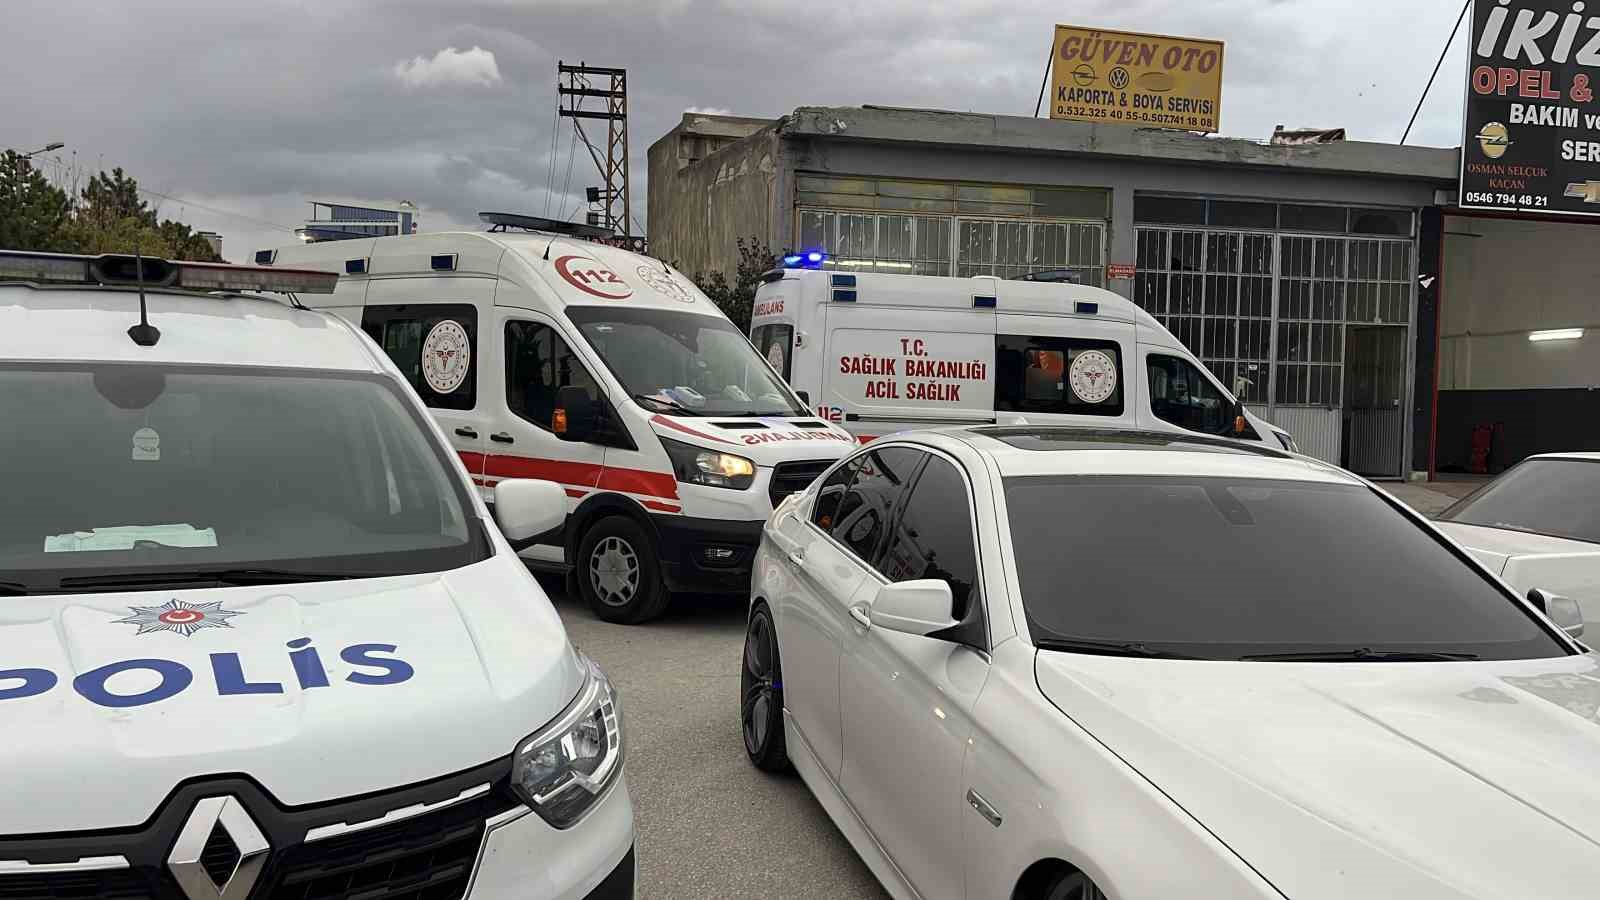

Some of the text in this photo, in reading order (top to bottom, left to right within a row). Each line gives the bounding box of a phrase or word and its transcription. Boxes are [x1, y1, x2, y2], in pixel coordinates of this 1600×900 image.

[1060, 32, 1217, 74] GÜVEN OTO
[1472, 66, 1593, 102] OPEL &
[1058, 86, 1115, 107] KAPORTA
[1120, 93, 1128, 108] &
[1133, 94, 1163, 111] BOYA
[1110, 109, 1123, 119] 40
[1187, 116, 1198, 126] 18
[1200, 118, 1213, 128] 08
[1509, 103, 1579, 128] BAKIM
[1467, 163, 1505, 175] OSMAN
[1466, 191, 1548, 206] 0546 794 48 21
[571, 269, 625, 284] 112
[901, 338, 928, 357] T.C.
[840, 354, 986, 381] SAĞLIK BAKANLIĞI
[865, 378, 961, 402] ACİL SAĞLIK
[818, 406, 842, 422] 112
[0, 637, 414, 708] POLİS
